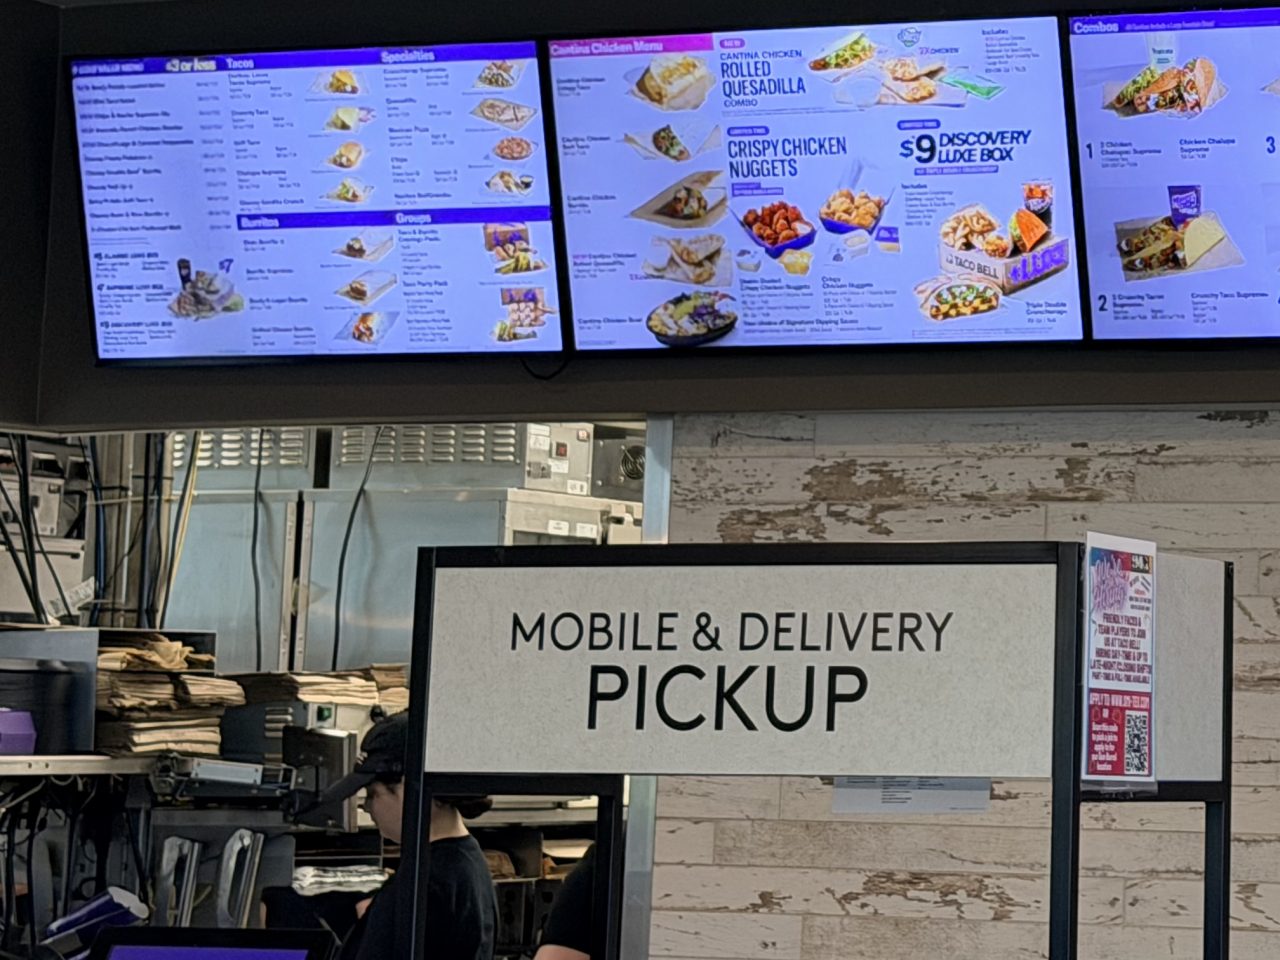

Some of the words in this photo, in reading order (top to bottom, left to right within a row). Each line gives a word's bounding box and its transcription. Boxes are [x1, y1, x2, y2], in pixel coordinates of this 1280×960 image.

[1073, 20, 1119, 34] Combos
[550, 42, 590, 55] Cantina
[591, 42, 632, 54] Chicken
[634, 40, 664, 52] Menu
[720, 52, 760, 60] CANTINA
[762, 50, 802, 58] CHICKEN
[226, 58, 254, 69] Tacos
[380, 50, 436, 64] Specialties
[720, 60, 772, 79] ROLLED
[722, 77, 806, 98] QUESADILLA
[723, 98, 758, 108] COMBO
[728, 139, 780, 159] CRISPY
[782, 136, 848, 157] CHICKEN
[899, 134, 937, 164] $9
[938, 130, 1032, 147] DISCOVERY
[1086, 142, 1093, 159] 1
[1266, 136, 1276, 154] 3
[938, 148, 978, 164] LUXE
[980, 146, 1014, 162] BOX
[728, 158, 798, 179] NUGGETS
[240, 216, 280, 228] Burritos
[396, 212, 432, 225] Groups
[953, 254, 976, 272] TACO
[977, 262, 999, 280] BELL
[1098, 294, 1108, 312] 2
[510, 611, 679, 652] MOBILE
[692, 611, 724, 652] &
[738, 611, 955, 653] DELIVERY
[1098, 624, 1110, 635] TEAM
[587, 664, 869, 732] PICKUP
